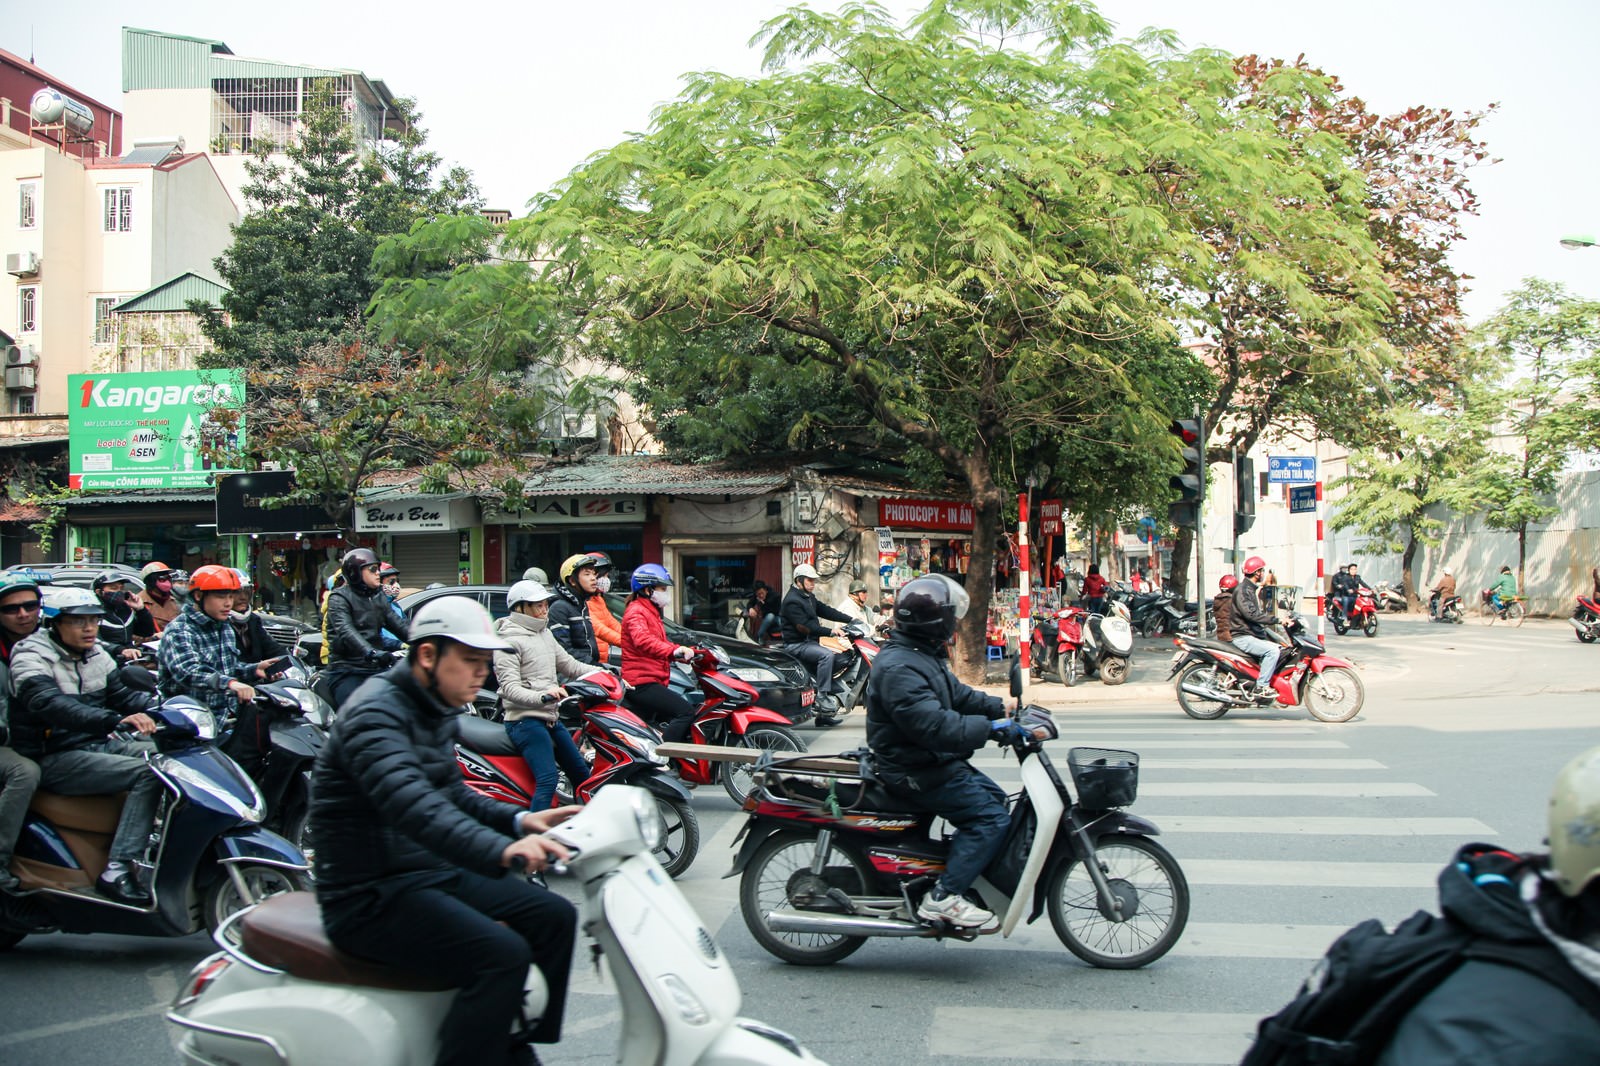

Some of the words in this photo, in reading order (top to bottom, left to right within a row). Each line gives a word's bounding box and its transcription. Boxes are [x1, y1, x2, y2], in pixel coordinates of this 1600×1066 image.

[129, 447, 156, 457] ASEN
[115, 476, 139, 486] CÔNG
[140, 477, 163, 486] MINH
[407, 506, 441, 521] Ben
[884, 503, 940, 523] PHOTOCOPY
[947, 507, 957, 524] IN
[1041, 503, 1060, 516] PHOTO
[1043, 520, 1059, 533] COPY
[791, 535, 814, 549] PHOTO
[791, 551, 812, 565] COPY
